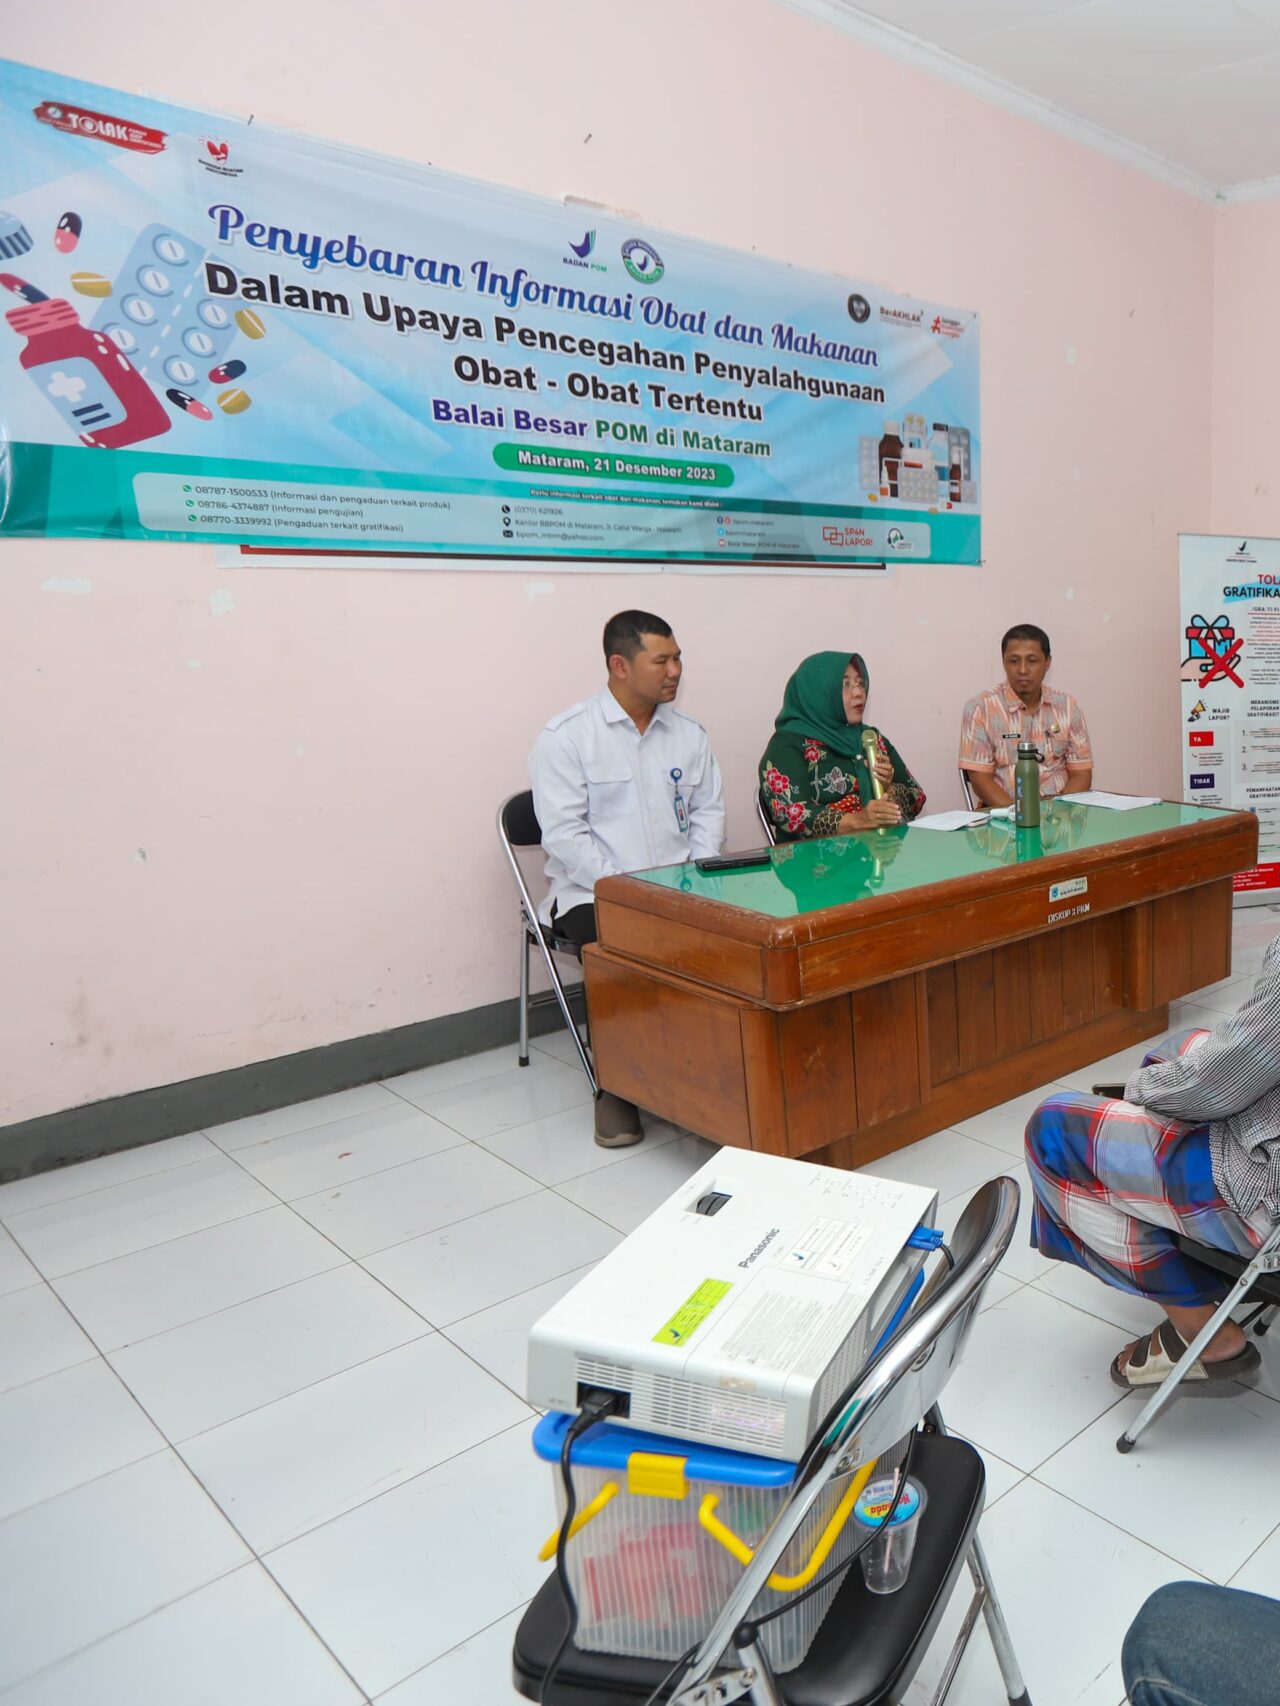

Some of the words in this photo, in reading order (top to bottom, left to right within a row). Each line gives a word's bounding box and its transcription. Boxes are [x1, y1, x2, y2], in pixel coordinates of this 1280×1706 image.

[563, 257, 589, 268] BADAN
[591, 262, 607, 272] POM
[208, 204, 462, 287] Penyebaran
[471, 261, 632, 320] Informasi
[640, 297, 707, 334] Obat
[714, 315, 763, 346] dan
[771, 324, 878, 366] Makanan
[205, 262, 350, 315] Dalam
[363, 292, 483, 339] Upaya
[495, 316, 685, 371] Pencegahan
[695, 352, 885, 402] Penyalahgunaan
[454, 355, 537, 390] Obat
[567, 373, 639, 404] Obat
[648, 384, 762, 420] Tertentu
[432, 399, 504, 427] Balai
[514, 409, 587, 436] Besar
[596, 420, 648, 443] POM
[655, 427, 675, 446] di
[683, 430, 771, 456] Mataram
[518, 450, 589, 472] Mataram,
[594, 458, 610, 472] 21
[616, 460, 682, 478] Desember
[686, 466, 715, 481] 2023
[195, 485, 268, 498] 08787-1500533
[271, 490, 317, 501] (Informasi
[320, 493, 337, 502] dan
[340, 496, 388, 507] pengaduan
[391, 498, 417, 507] terkait
[419, 499, 451, 510] produk)
[272, 504, 316, 515] (Informasi
[319, 507, 363, 518] pengujian)
[200, 514, 272, 526] 08770-3339992
[274, 517, 329, 529] (Pengaduan
[331, 519, 358, 530] terkait
[360, 521, 404, 532] gratifikasi)
[845, 528, 865, 537] SP4N
[845, 538, 873, 546] LAPOR!
[738, 1227, 780, 1269] Panasonic
